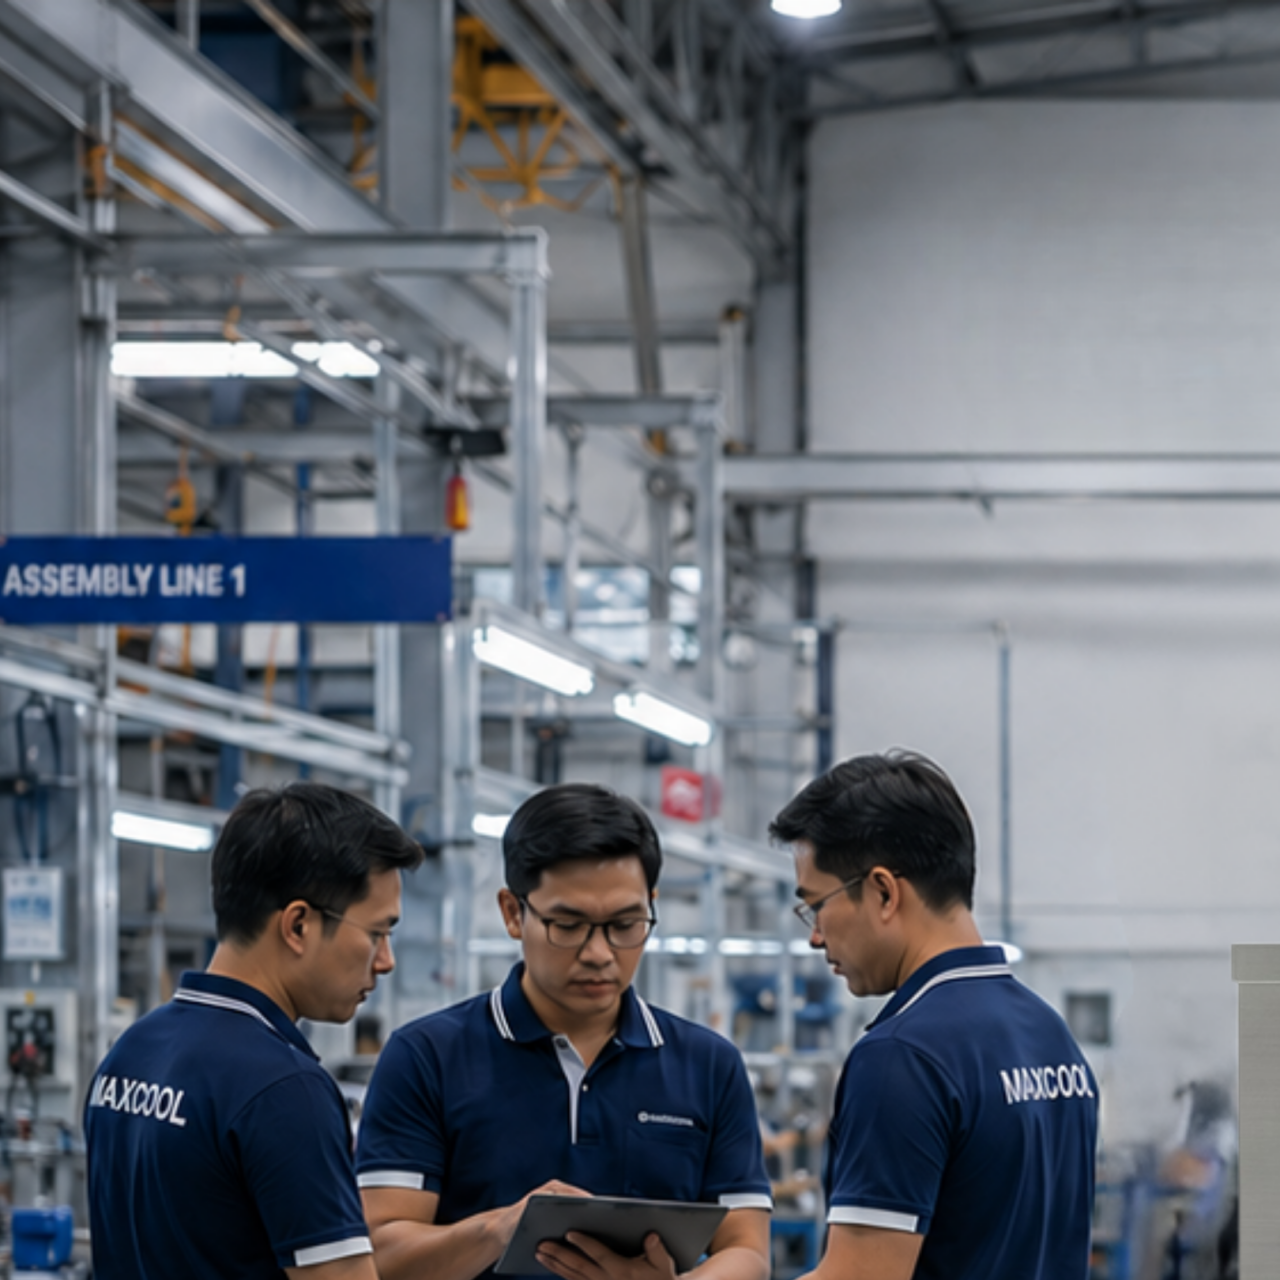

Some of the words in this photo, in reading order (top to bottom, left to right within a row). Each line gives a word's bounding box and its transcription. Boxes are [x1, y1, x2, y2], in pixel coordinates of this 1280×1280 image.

[3, 564, 153, 597] ASSEMBLY
[159, 564, 224, 597] LINE
[231, 564, 246, 597] 1
